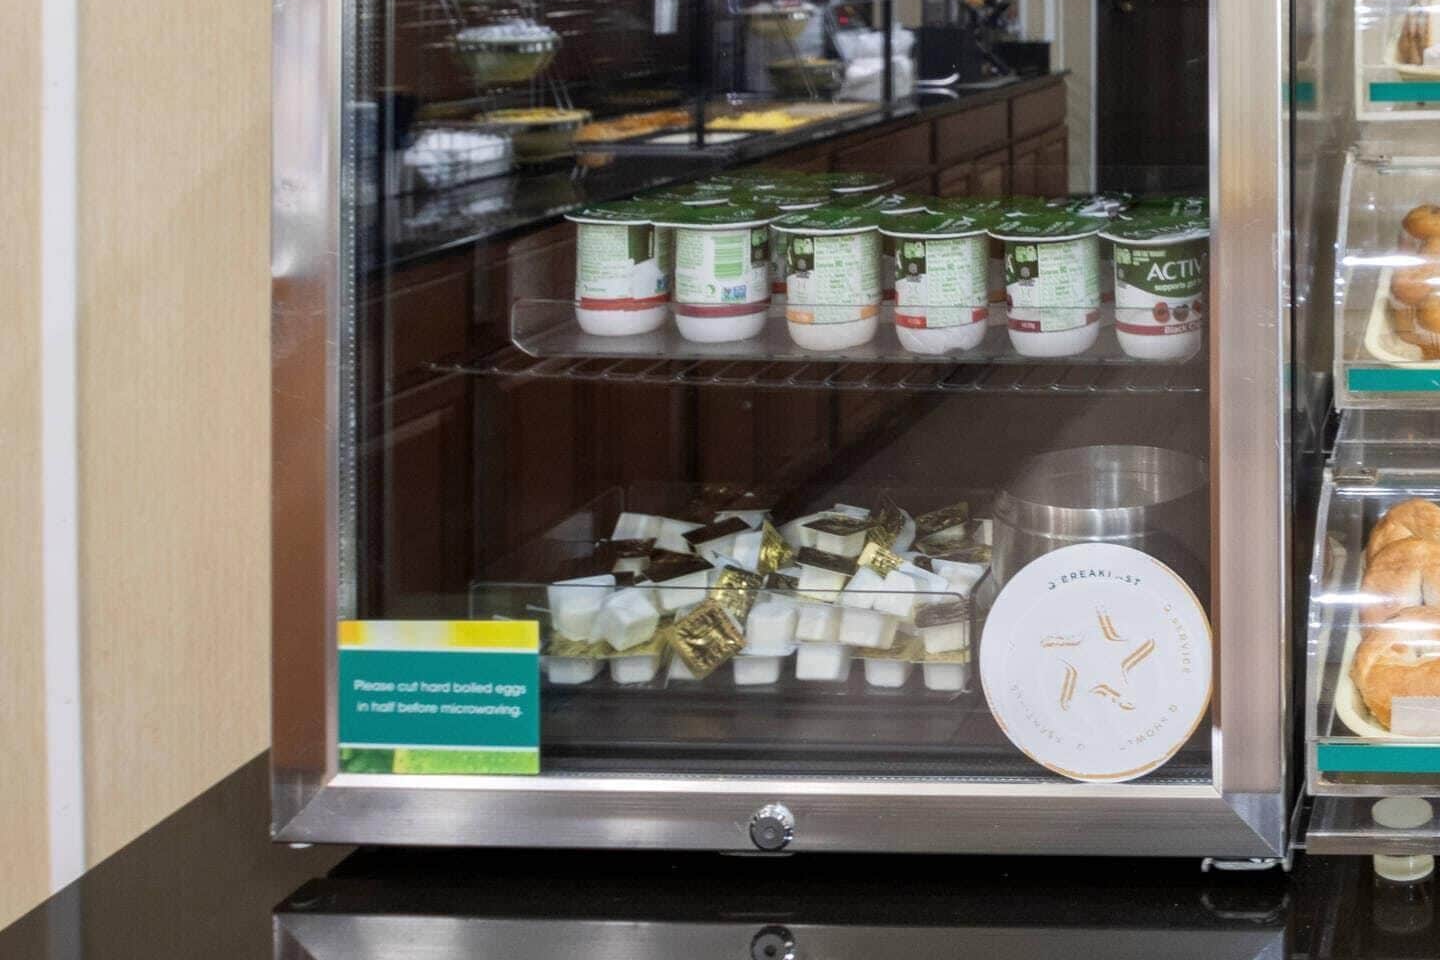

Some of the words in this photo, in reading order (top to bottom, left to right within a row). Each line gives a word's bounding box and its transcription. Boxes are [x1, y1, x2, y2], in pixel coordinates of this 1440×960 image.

[353, 679, 395, 692] Please
[397, 681, 419, 692] cut
[420, 681, 450, 694] hard
[452, 682, 493, 694] boiled
[494, 684, 527, 697] eggs
[356, 701, 369, 712] in
[370, 701, 396, 713] half
[397, 702, 438, 714] before
[440, 703, 523, 718] microwaving.
